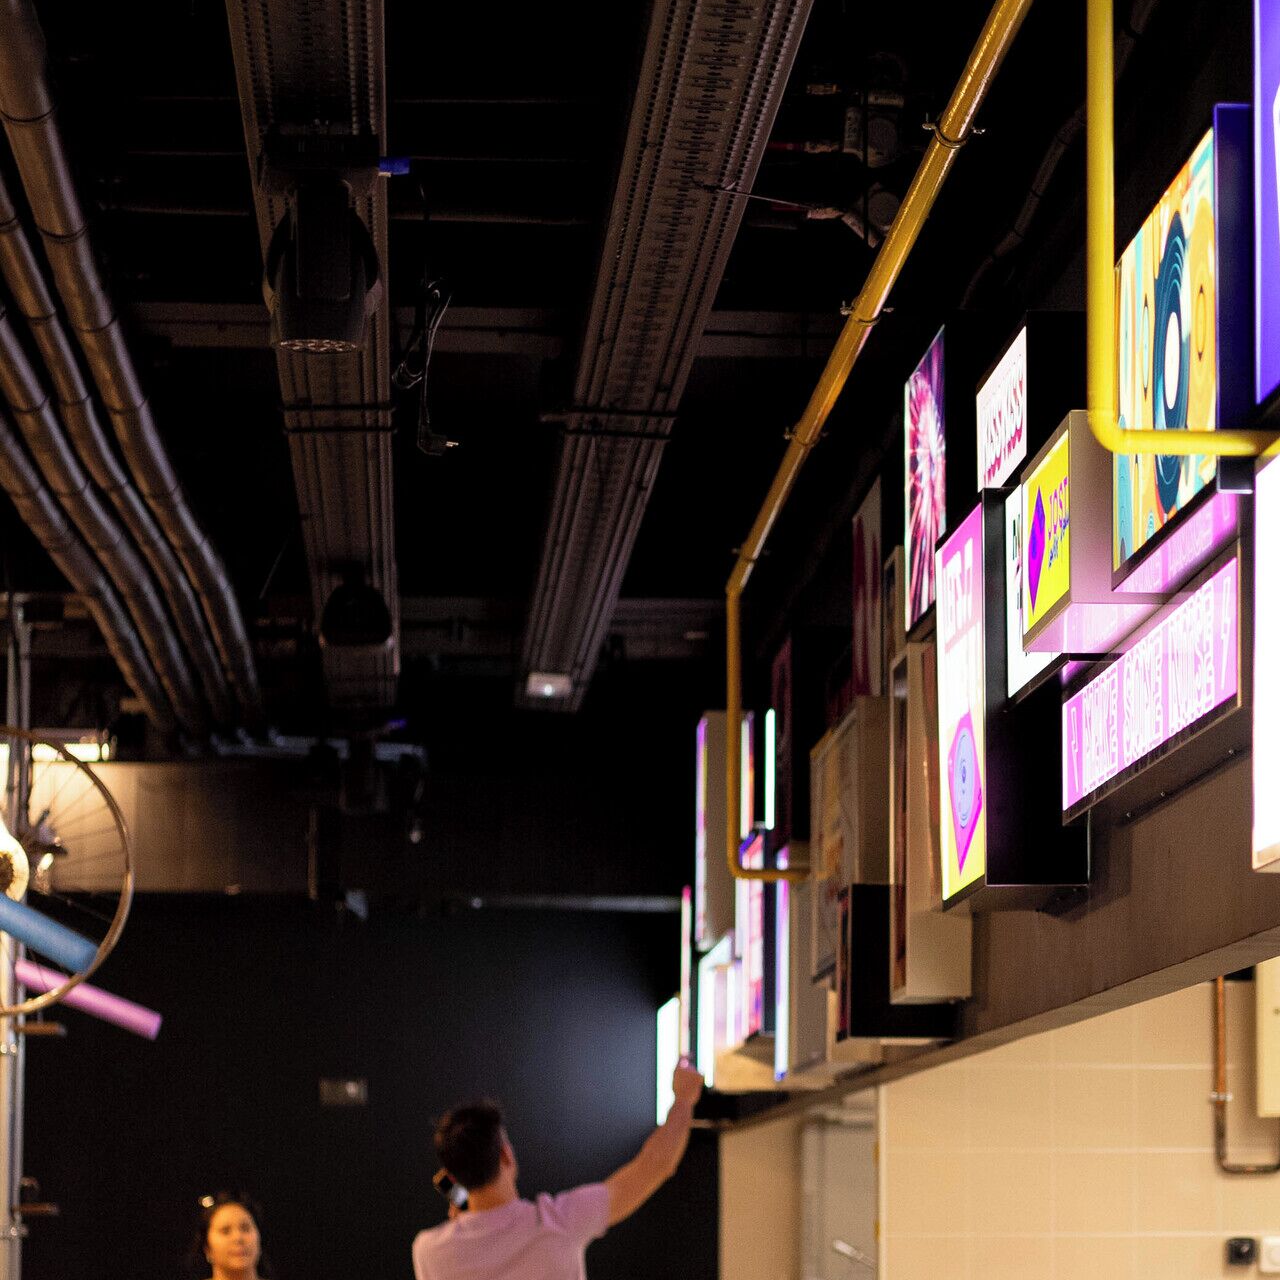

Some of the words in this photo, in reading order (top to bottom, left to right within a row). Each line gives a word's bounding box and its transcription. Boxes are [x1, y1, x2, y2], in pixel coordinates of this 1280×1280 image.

[1082, 666, 1118, 795] MAKE
[1123, 627, 1164, 766] SOME
[1167, 580, 1215, 736] NOISE
